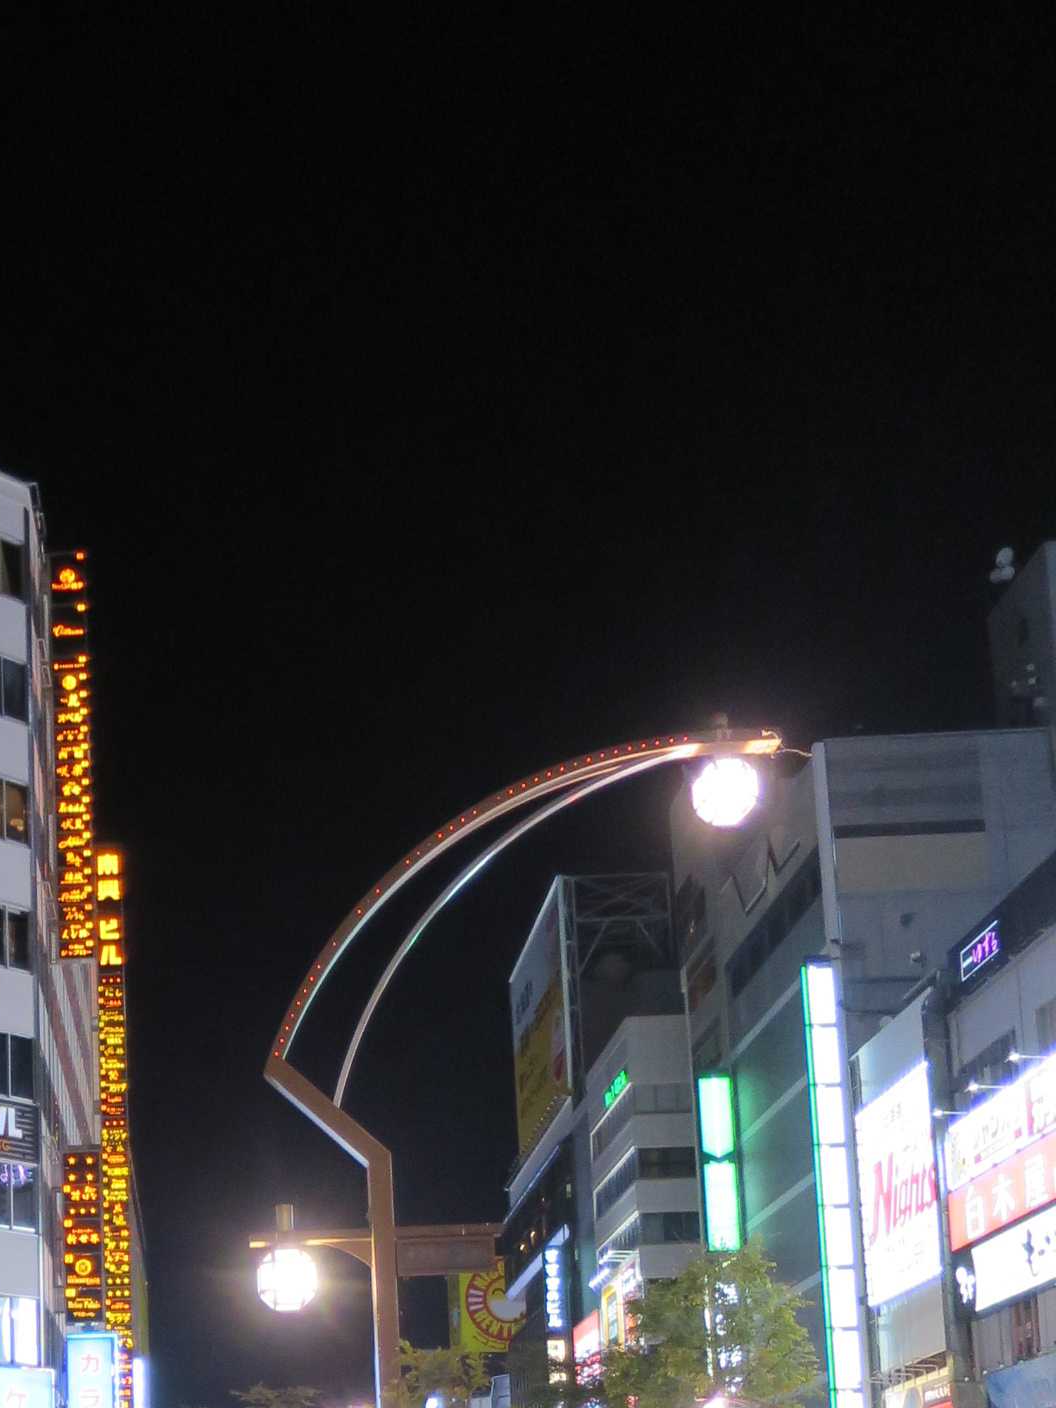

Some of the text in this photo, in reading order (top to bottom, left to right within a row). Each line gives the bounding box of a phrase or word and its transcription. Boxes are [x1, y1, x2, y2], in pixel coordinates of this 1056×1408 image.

[97, 854, 122, 966] 南興ビル
[964, 1154, 1049, 1240] 白木屋
